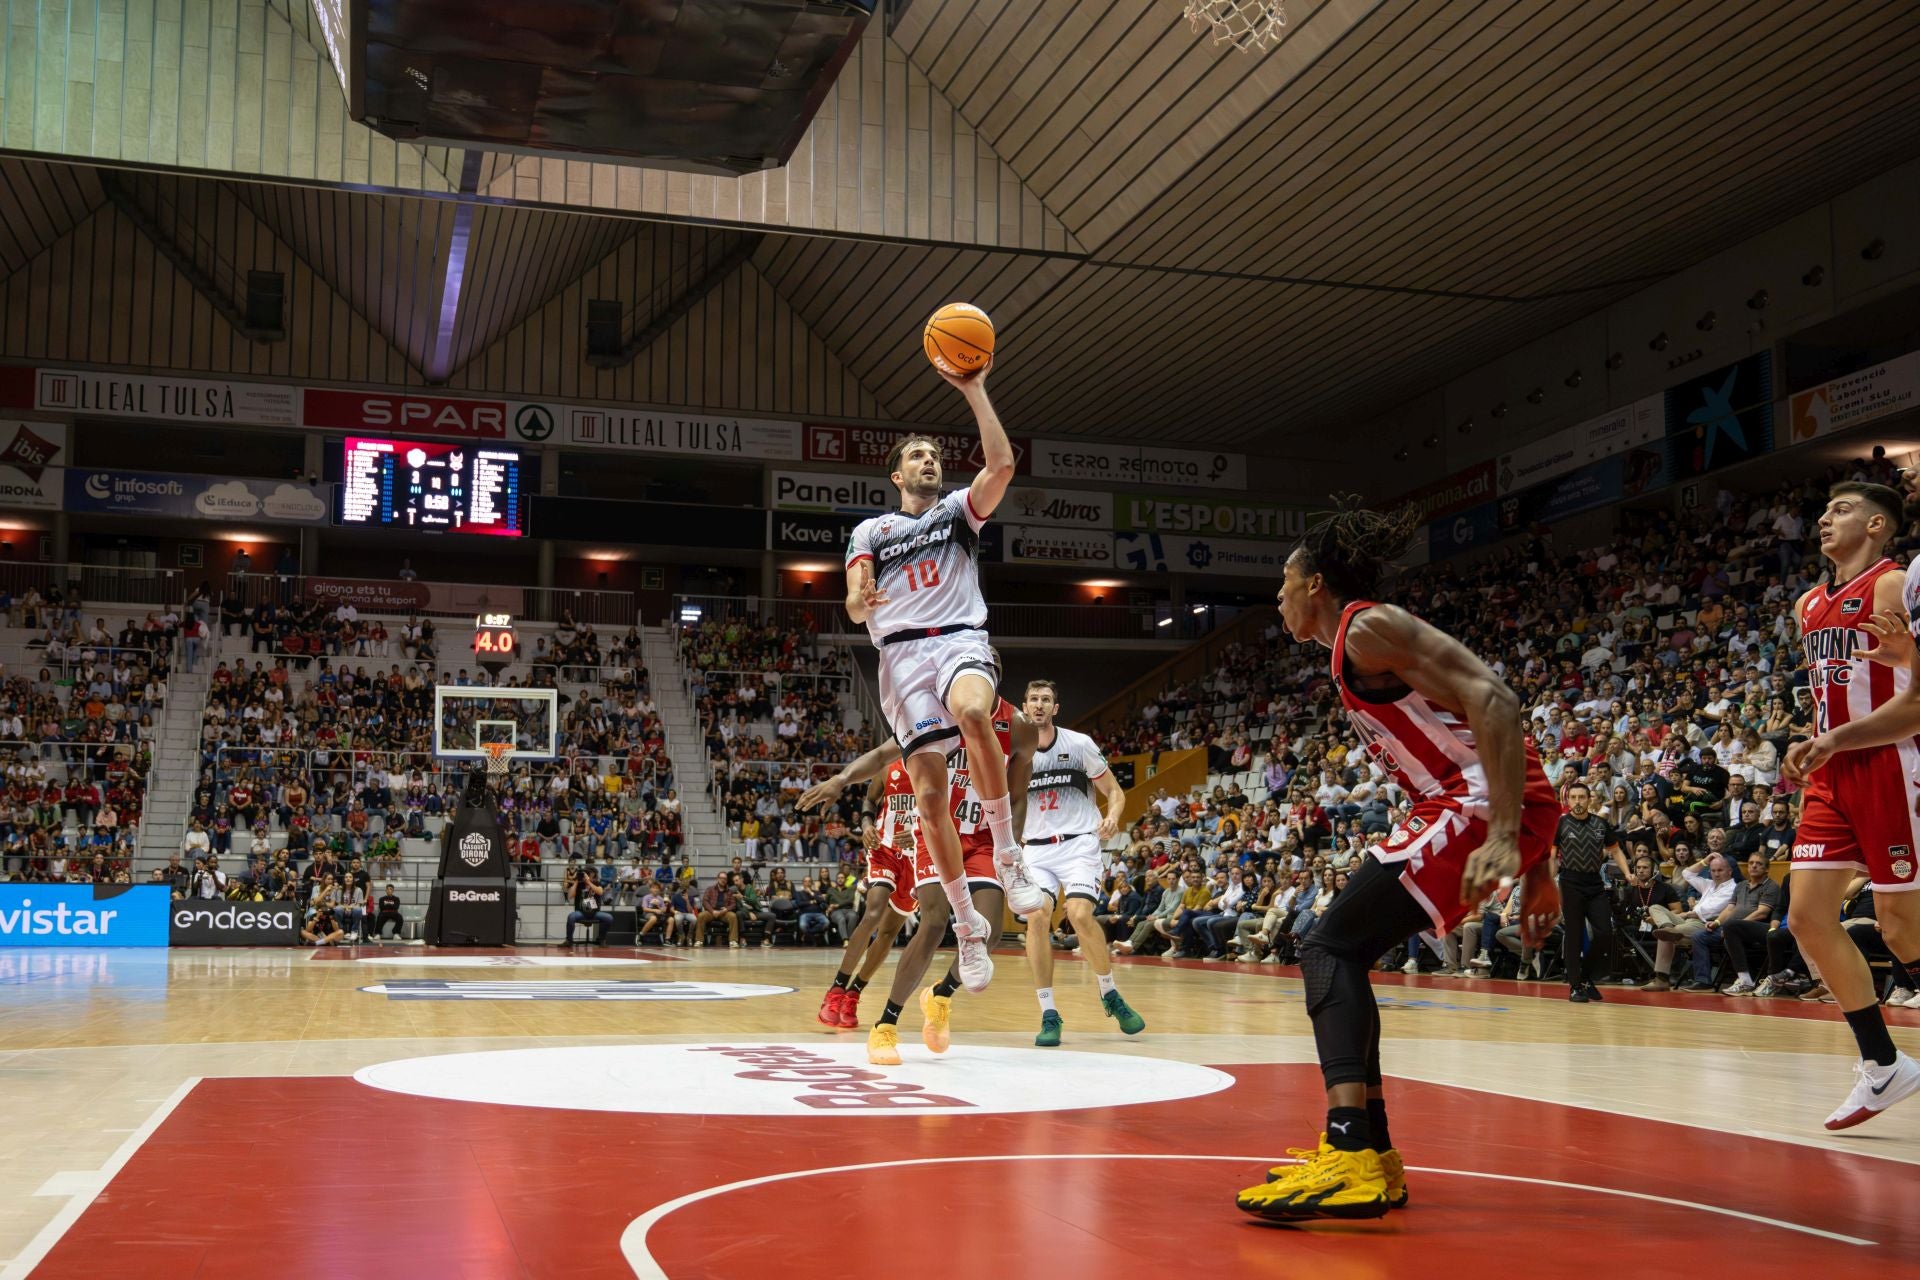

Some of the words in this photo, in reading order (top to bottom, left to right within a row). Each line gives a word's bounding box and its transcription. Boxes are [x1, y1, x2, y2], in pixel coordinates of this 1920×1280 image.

[957, 352, 975, 364] acb
[82, 381, 147, 413] LLEAL
[158, 385, 235, 419] TULSÀ
[362, 400, 504, 433] SPAR
[608, 416, 668, 448] LLEAL
[675, 420, 742, 452] TULSÀ
[12, 437, 46, 466] ibis
[1048, 452, 1110, 470] TERRA
[1119, 456, 1199, 477] REMOTA
[114, 476, 183, 496] infosoft
[778, 476, 886, 506] Panella
[1041, 498, 1101, 522] Abras
[1130, 500, 1307, 539] L'ESPORTIU
[781, 522, 833, 543] Kave
[901, 559, 941, 592] 10
[314, 582, 354, 598] girona
[356, 583, 376, 596] ets
[378, 584, 392, 597] tu
[479, 630, 513, 653] 4.0
[954, 800, 982, 825] 46
[449, 890, 501, 902] BeGreat
[0, 899, 118, 936] vistar
[174, 906, 293, 930] endesa
